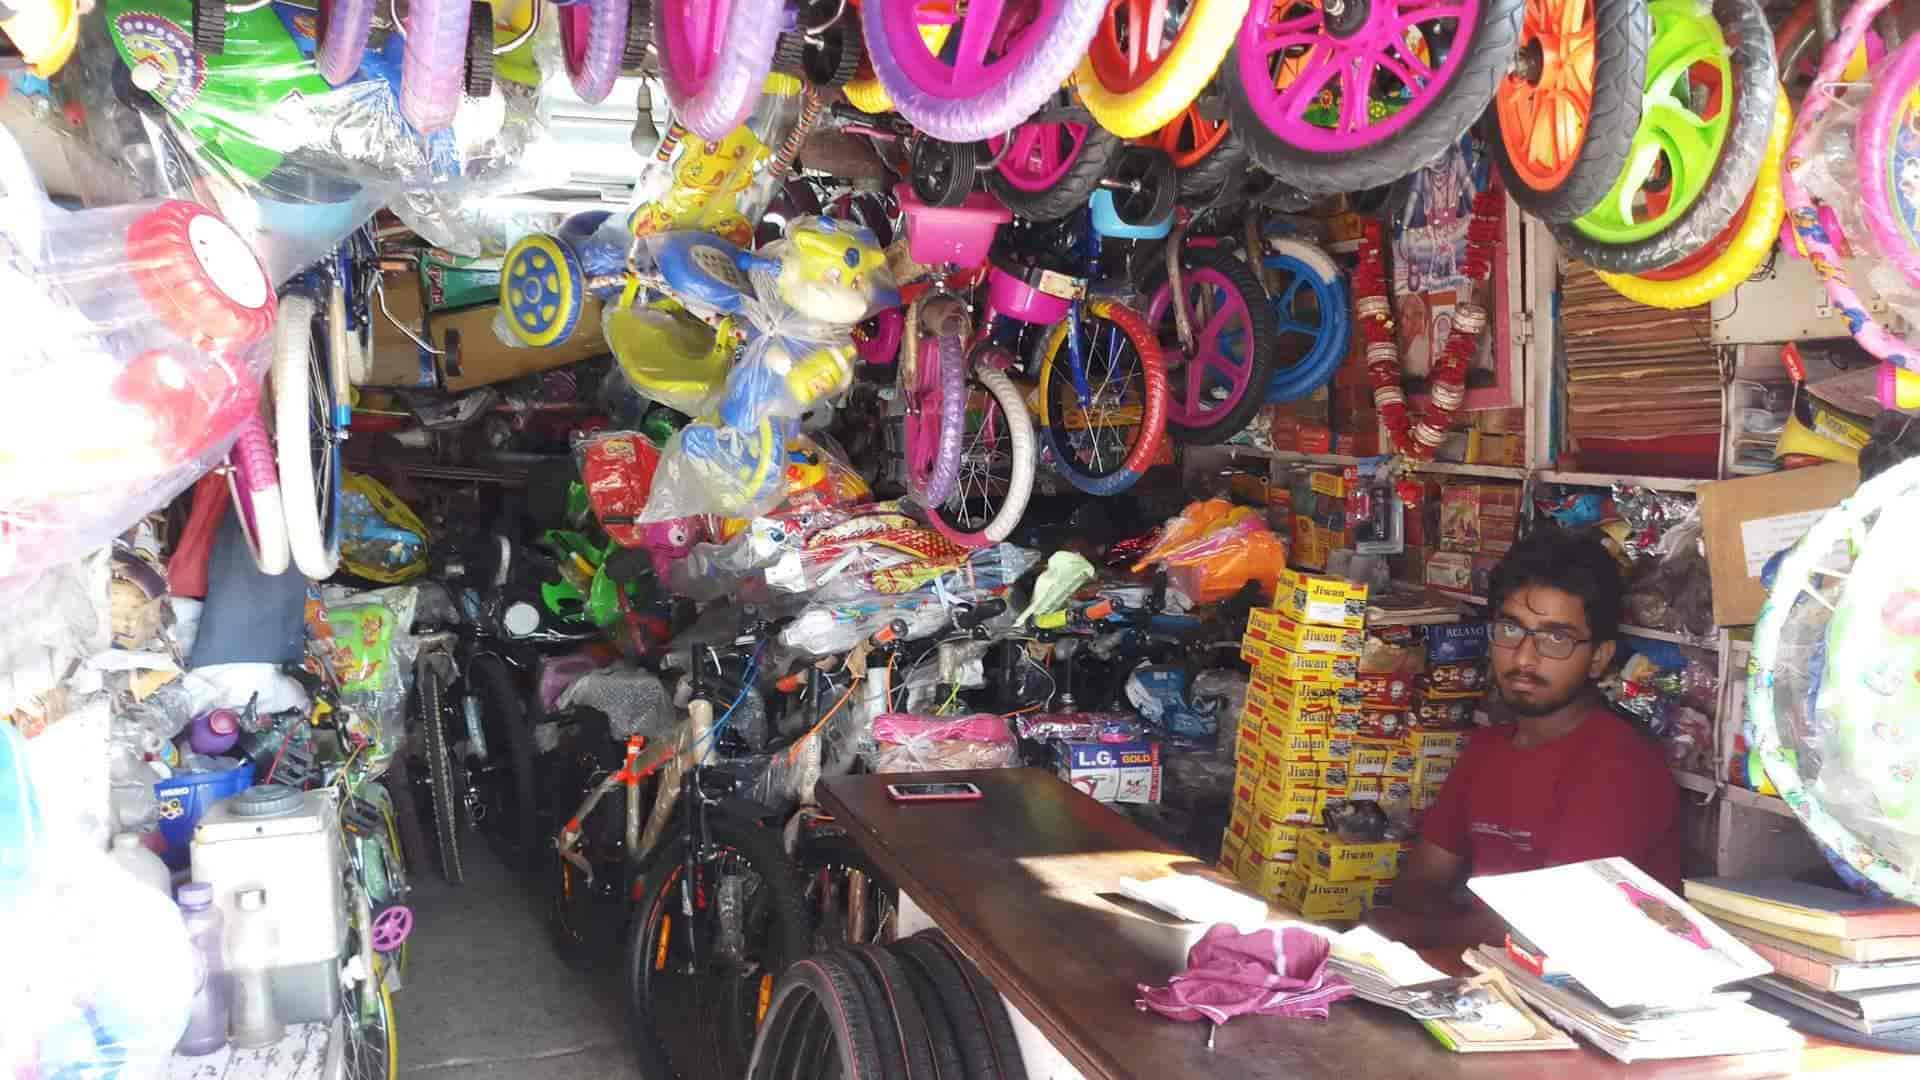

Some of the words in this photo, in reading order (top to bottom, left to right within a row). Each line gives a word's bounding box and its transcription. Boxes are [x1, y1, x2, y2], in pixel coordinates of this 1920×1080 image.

[1313, 585, 1345, 598] Jiwan
[1302, 628, 1337, 642] Jiwan
[1296, 656, 1328, 669] Jiwan
[1291, 736, 1324, 749] Jiwan
[1079, 751, 1117, 768] L.G.
[1121, 754, 1152, 764] GOLD
[1339, 849, 1374, 860] Jiwan
[1311, 883, 1348, 895] Jiwan
